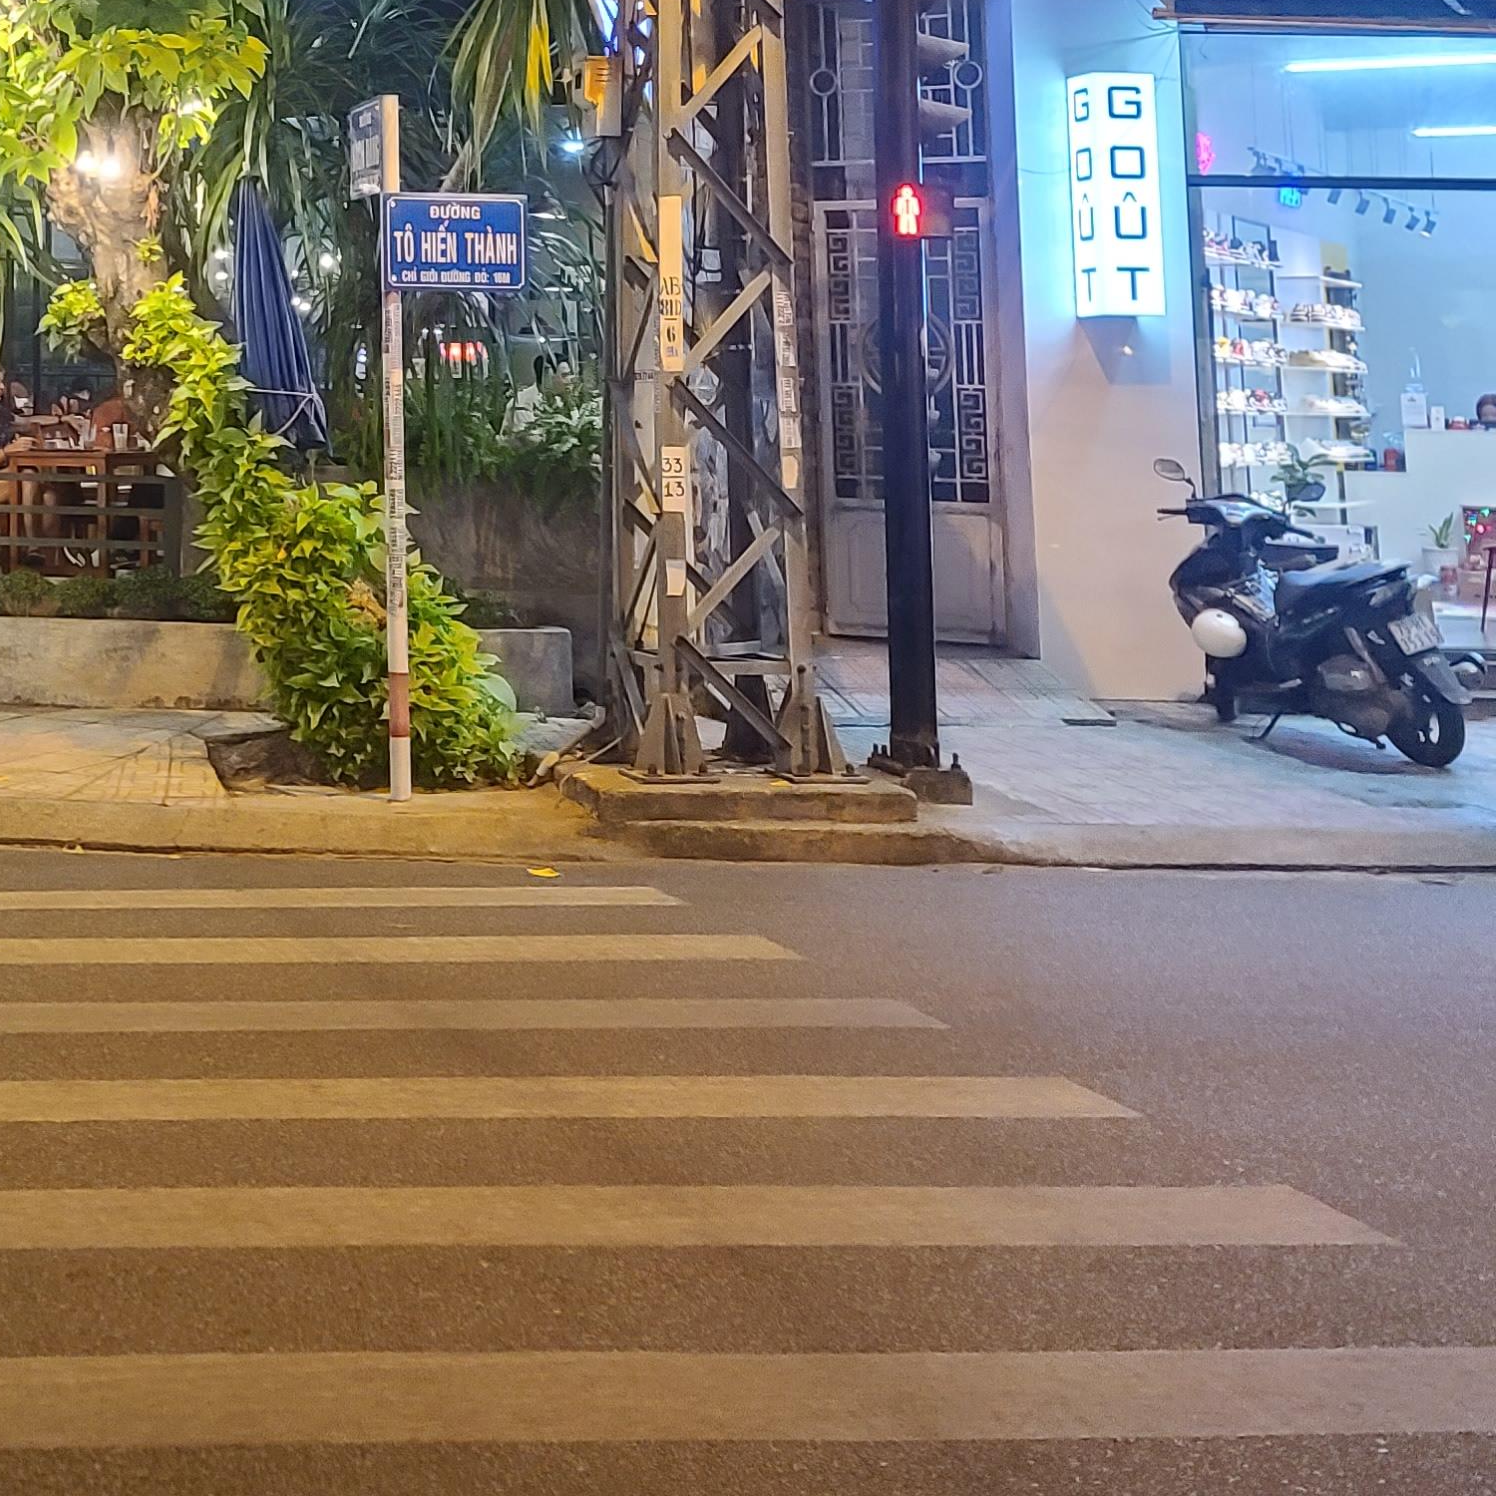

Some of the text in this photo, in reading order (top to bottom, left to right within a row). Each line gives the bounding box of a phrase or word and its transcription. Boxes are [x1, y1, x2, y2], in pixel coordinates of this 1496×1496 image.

[429, 202, 481, 219] ĐƯỜNG
[394, 220, 517, 265] TÔ HIẾN THÀNH
[660, 276, 681, 296] AB
[662, 457, 683, 473] 33
[664, 481, 685, 498] 13
